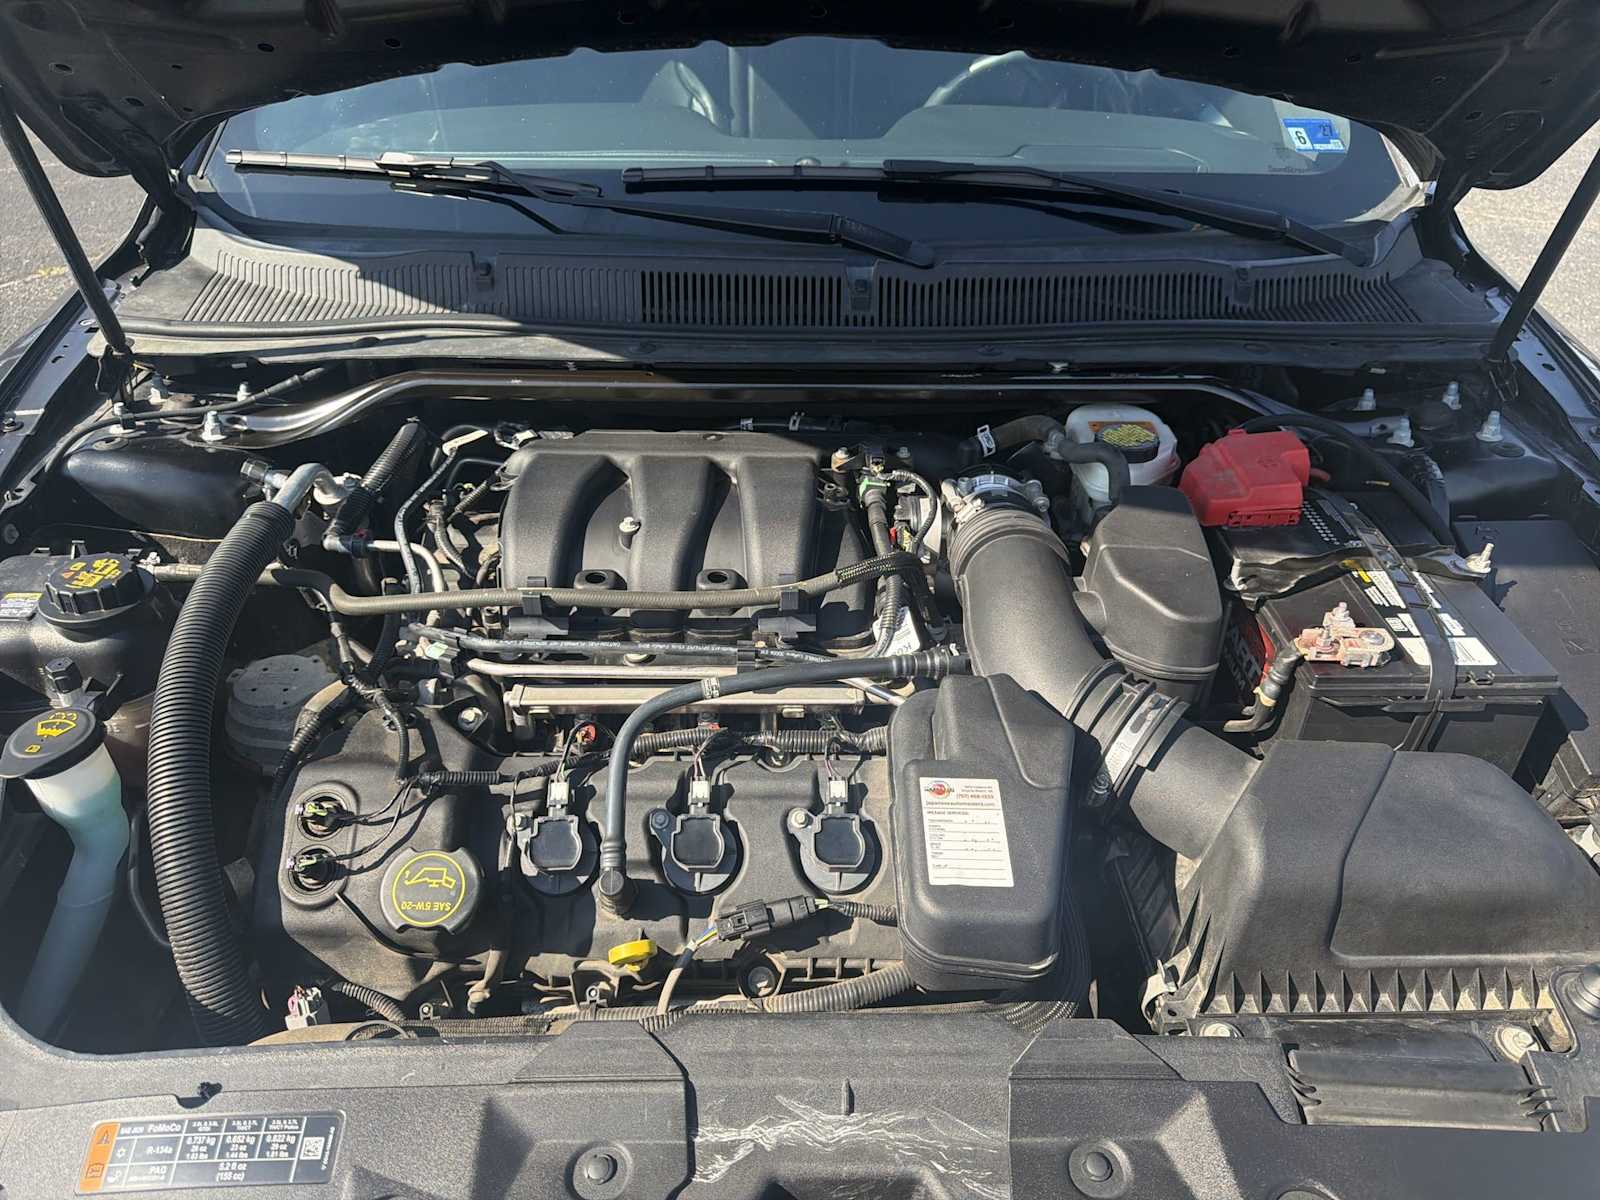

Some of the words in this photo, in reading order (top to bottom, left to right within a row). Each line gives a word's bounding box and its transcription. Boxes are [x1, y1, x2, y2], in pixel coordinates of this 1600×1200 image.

[1294, 130, 1308, 145] 6
[401, 900, 432, 911] 5W-20
[433, 901, 452, 912] SAE
[147, 1122, 182, 1133] FoMoCo
[206, 1136, 217, 1146] kg
[225, 1135, 246, 1144] 0.652
[245, 1135, 256, 1145] kg
[286, 1134, 296, 1144] kg
[146, 1145, 173, 1155] R-134a
[218, 1162, 231, 1171] 5.2
[237, 1163, 247, 1171] oz
[232, 1172, 246, 1182] cc)
